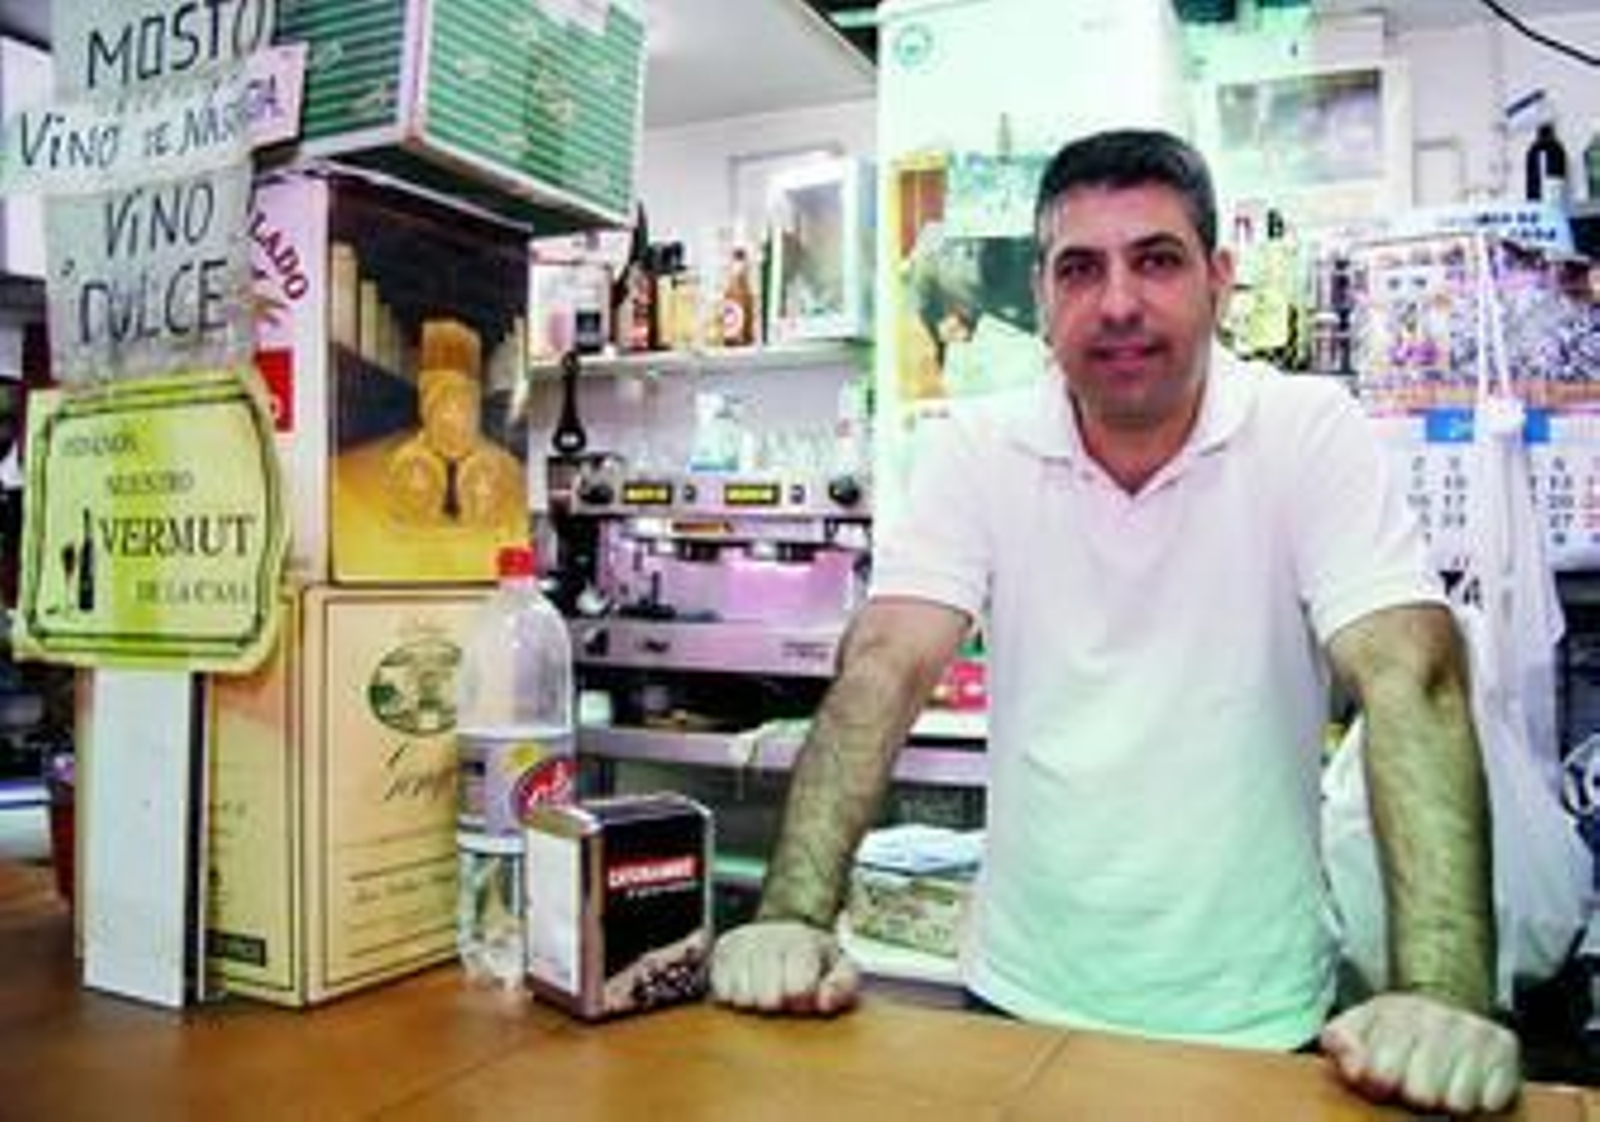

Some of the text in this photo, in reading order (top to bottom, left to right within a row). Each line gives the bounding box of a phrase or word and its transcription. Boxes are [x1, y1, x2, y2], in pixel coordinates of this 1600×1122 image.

[87, 0, 265, 88] MOSTO
[79, 259, 228, 344] DULCE
[98, 514, 257, 558] VERMUT
